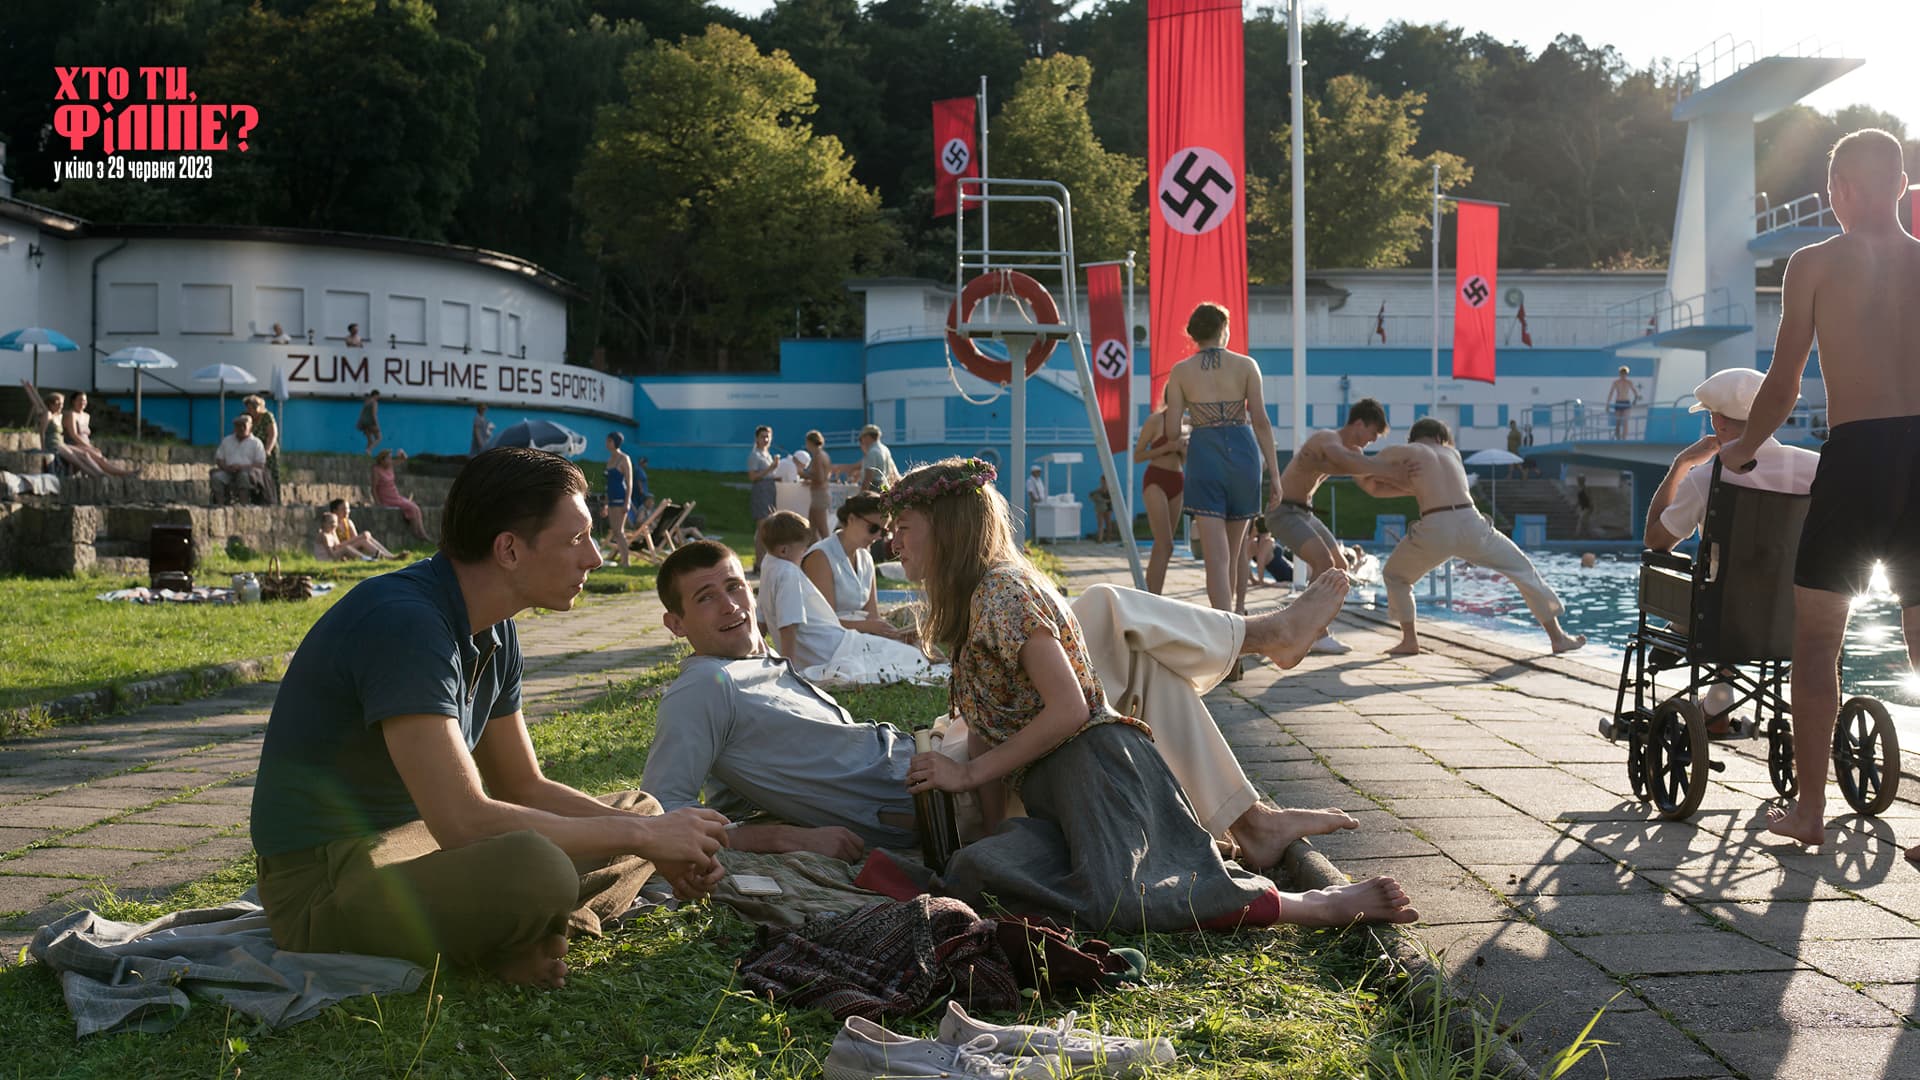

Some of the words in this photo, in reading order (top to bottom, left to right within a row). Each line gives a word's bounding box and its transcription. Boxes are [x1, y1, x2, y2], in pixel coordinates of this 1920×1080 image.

[287, 354, 369, 383] ZUM
[384, 358, 488, 390] RUHME
[498, 366, 543, 394] DES
[550, 371, 598, 402] SPORTS
